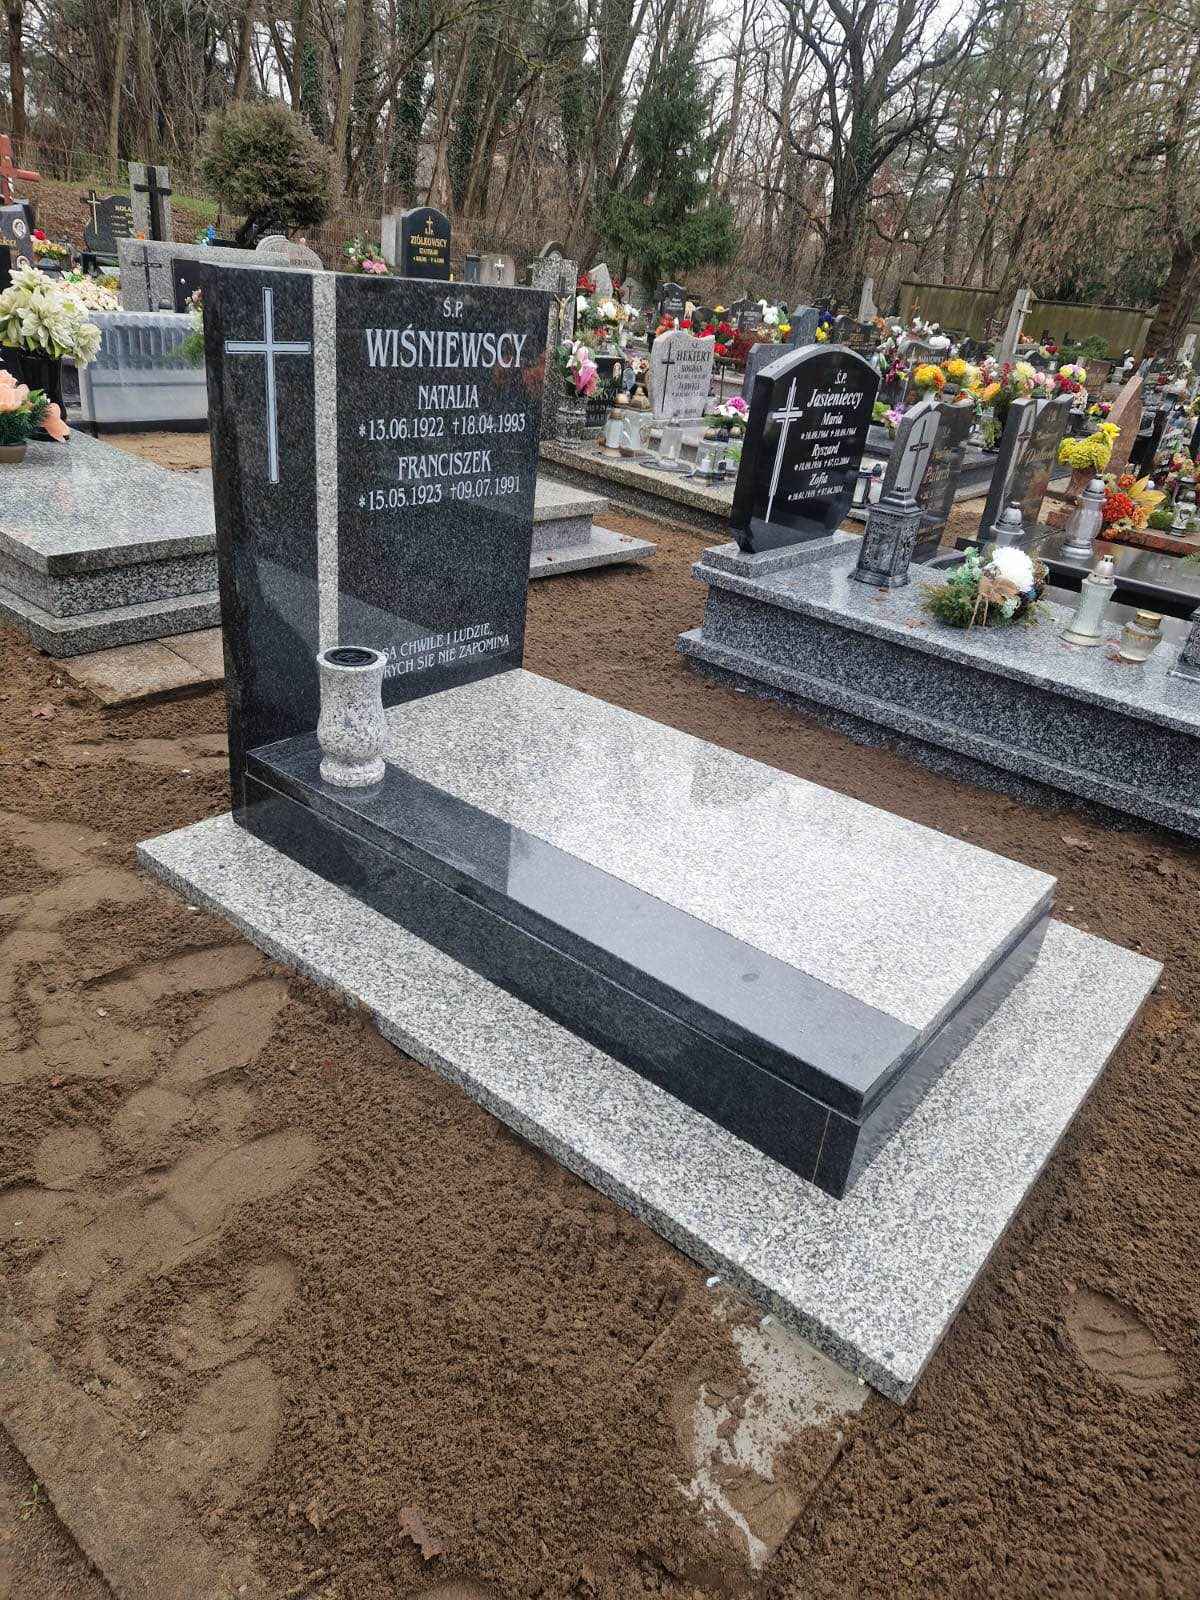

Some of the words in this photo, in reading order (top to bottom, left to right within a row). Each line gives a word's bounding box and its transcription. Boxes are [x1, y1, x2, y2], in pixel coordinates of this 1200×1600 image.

[365, 324, 528, 368] WIŚNIEWSCY
[418, 384, 479, 410] NATALIA
[820, 411, 843, 426] Maria
[811, 442, 840, 459] Ryszard
[398, 449, 492, 480] FRANCISZEK
[808, 471, 829, 487] Zofia
[384, 658, 414, 679] RYCH
[438, 647, 456, 664] NIE
[459, 633, 510, 659] ZAPOMINA
[400, 634, 444, 657] CHWILE
